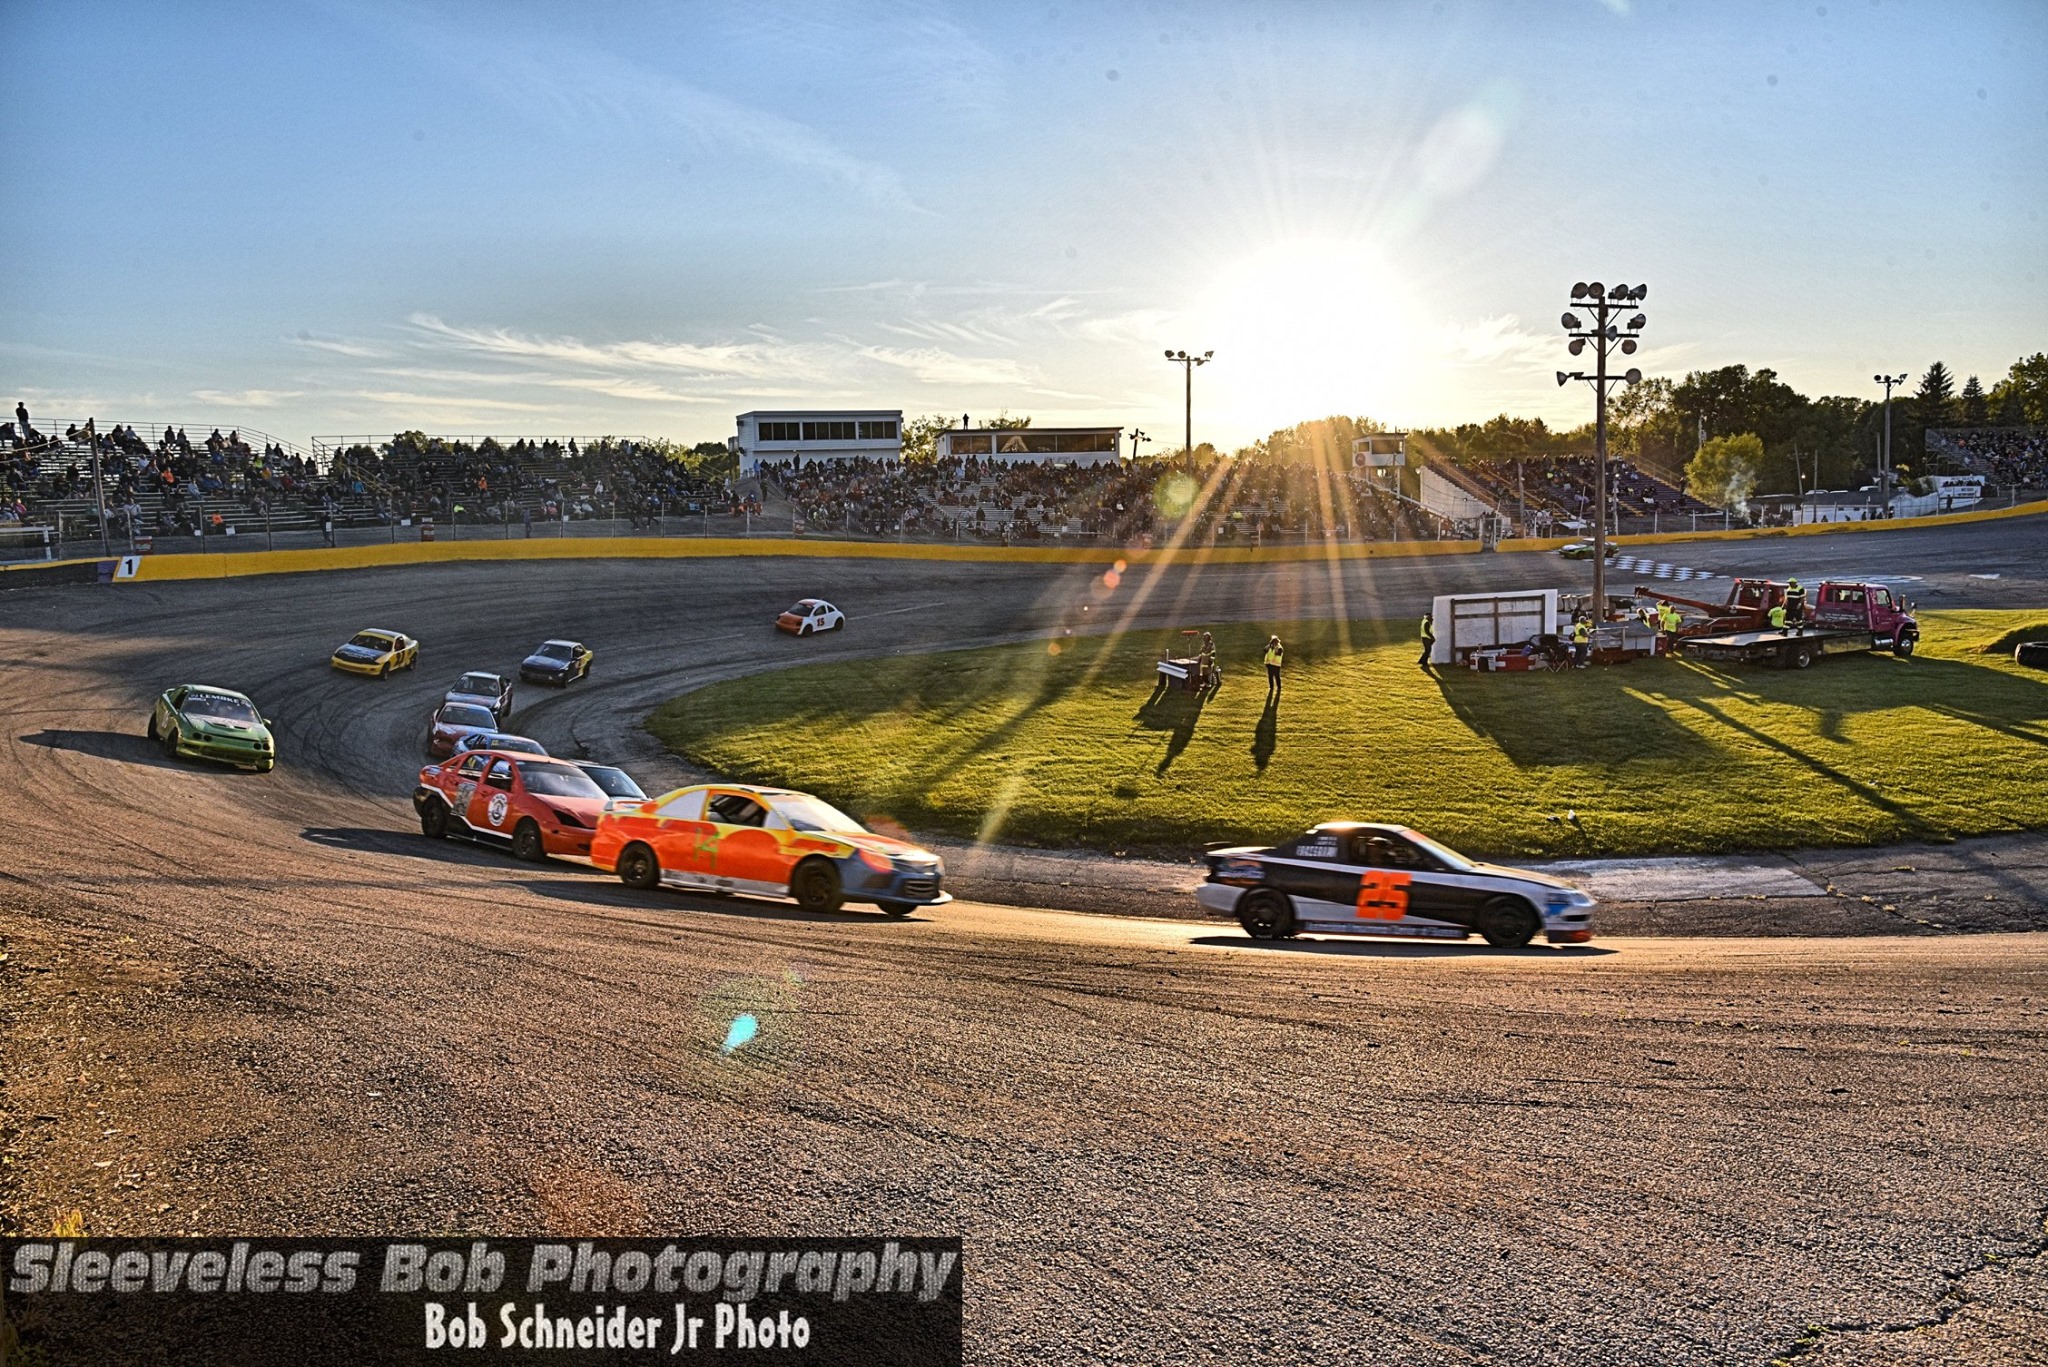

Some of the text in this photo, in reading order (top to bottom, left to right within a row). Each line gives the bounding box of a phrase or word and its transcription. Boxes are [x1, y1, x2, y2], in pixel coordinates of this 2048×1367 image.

[125, 559, 133, 575] 1
[200, 693, 240, 703] LEMBKE
[693, 827, 720, 870] 14
[1356, 870, 1414, 921] 25
